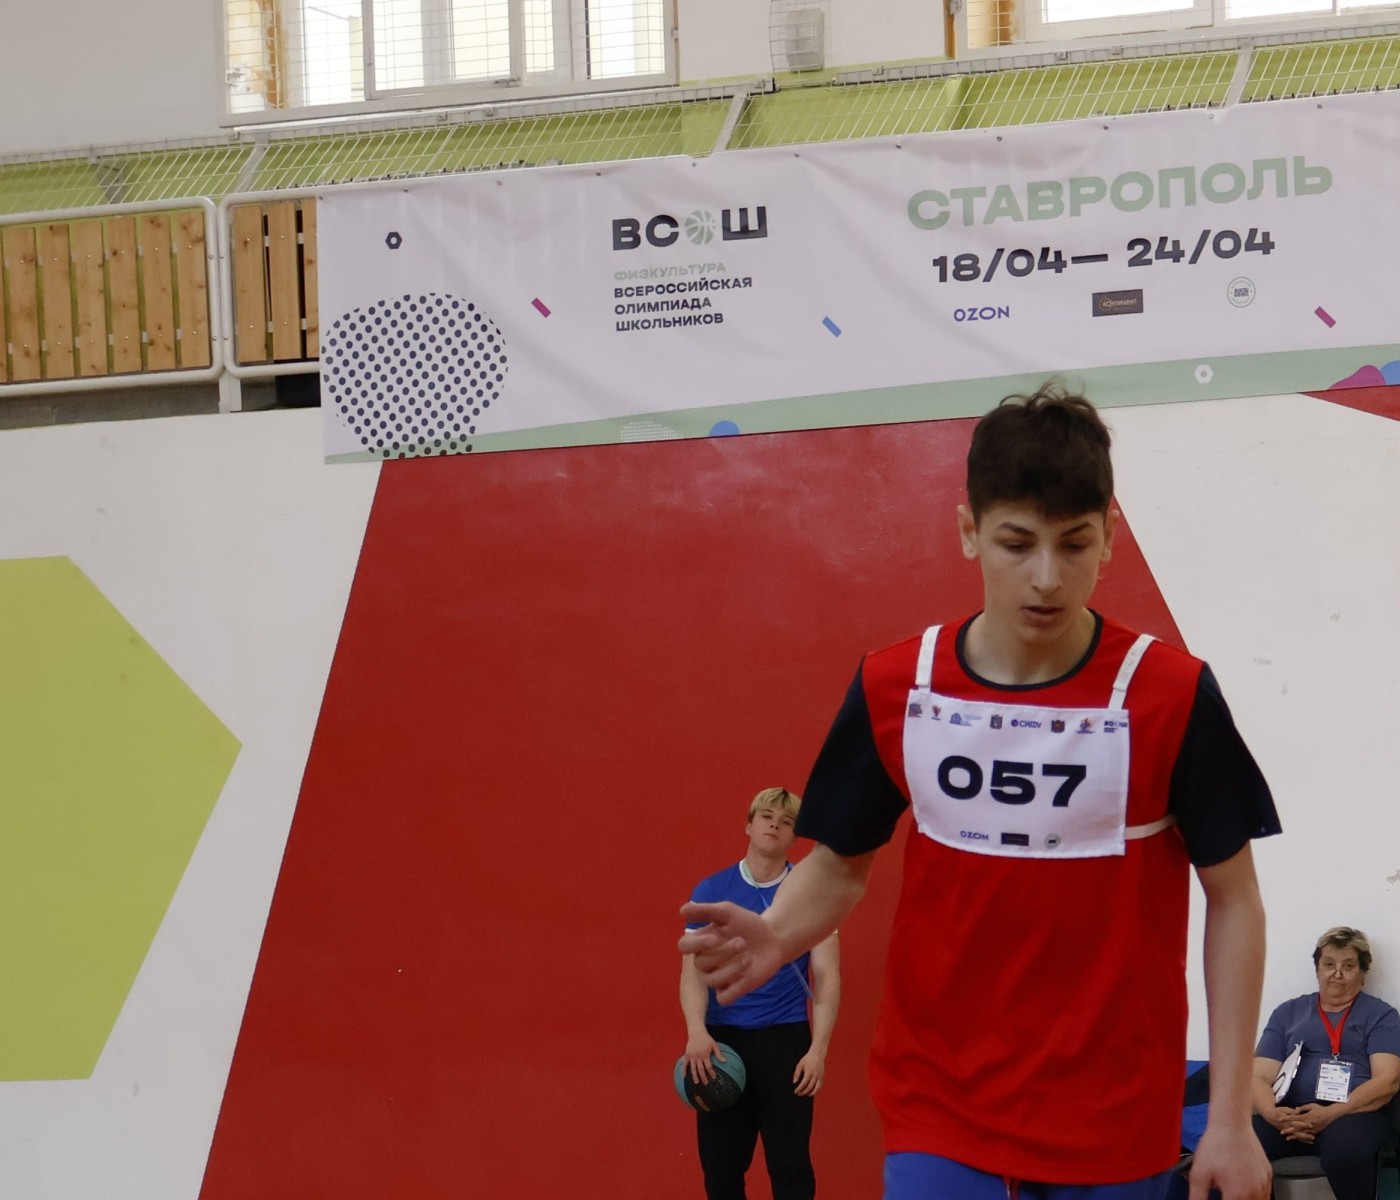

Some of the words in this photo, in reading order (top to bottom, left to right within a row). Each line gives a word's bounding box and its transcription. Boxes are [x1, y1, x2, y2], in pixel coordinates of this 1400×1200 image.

[907, 155, 1333, 230] СТАВРОПОЛЬ
[1126, 228, 1275, 268] 24/04
[614, 262, 727, 281] ФИЗКУЛЬТУРА
[614, 277, 753, 298] ВСЕРОССИЙСКАЯ
[615, 297, 712, 315] ОЛИМПИАДА
[953, 305, 1010, 323] OZON
[616, 313, 724, 332] ШКОЛЬНИКОВ
[937, 755, 1087, 808] 057
